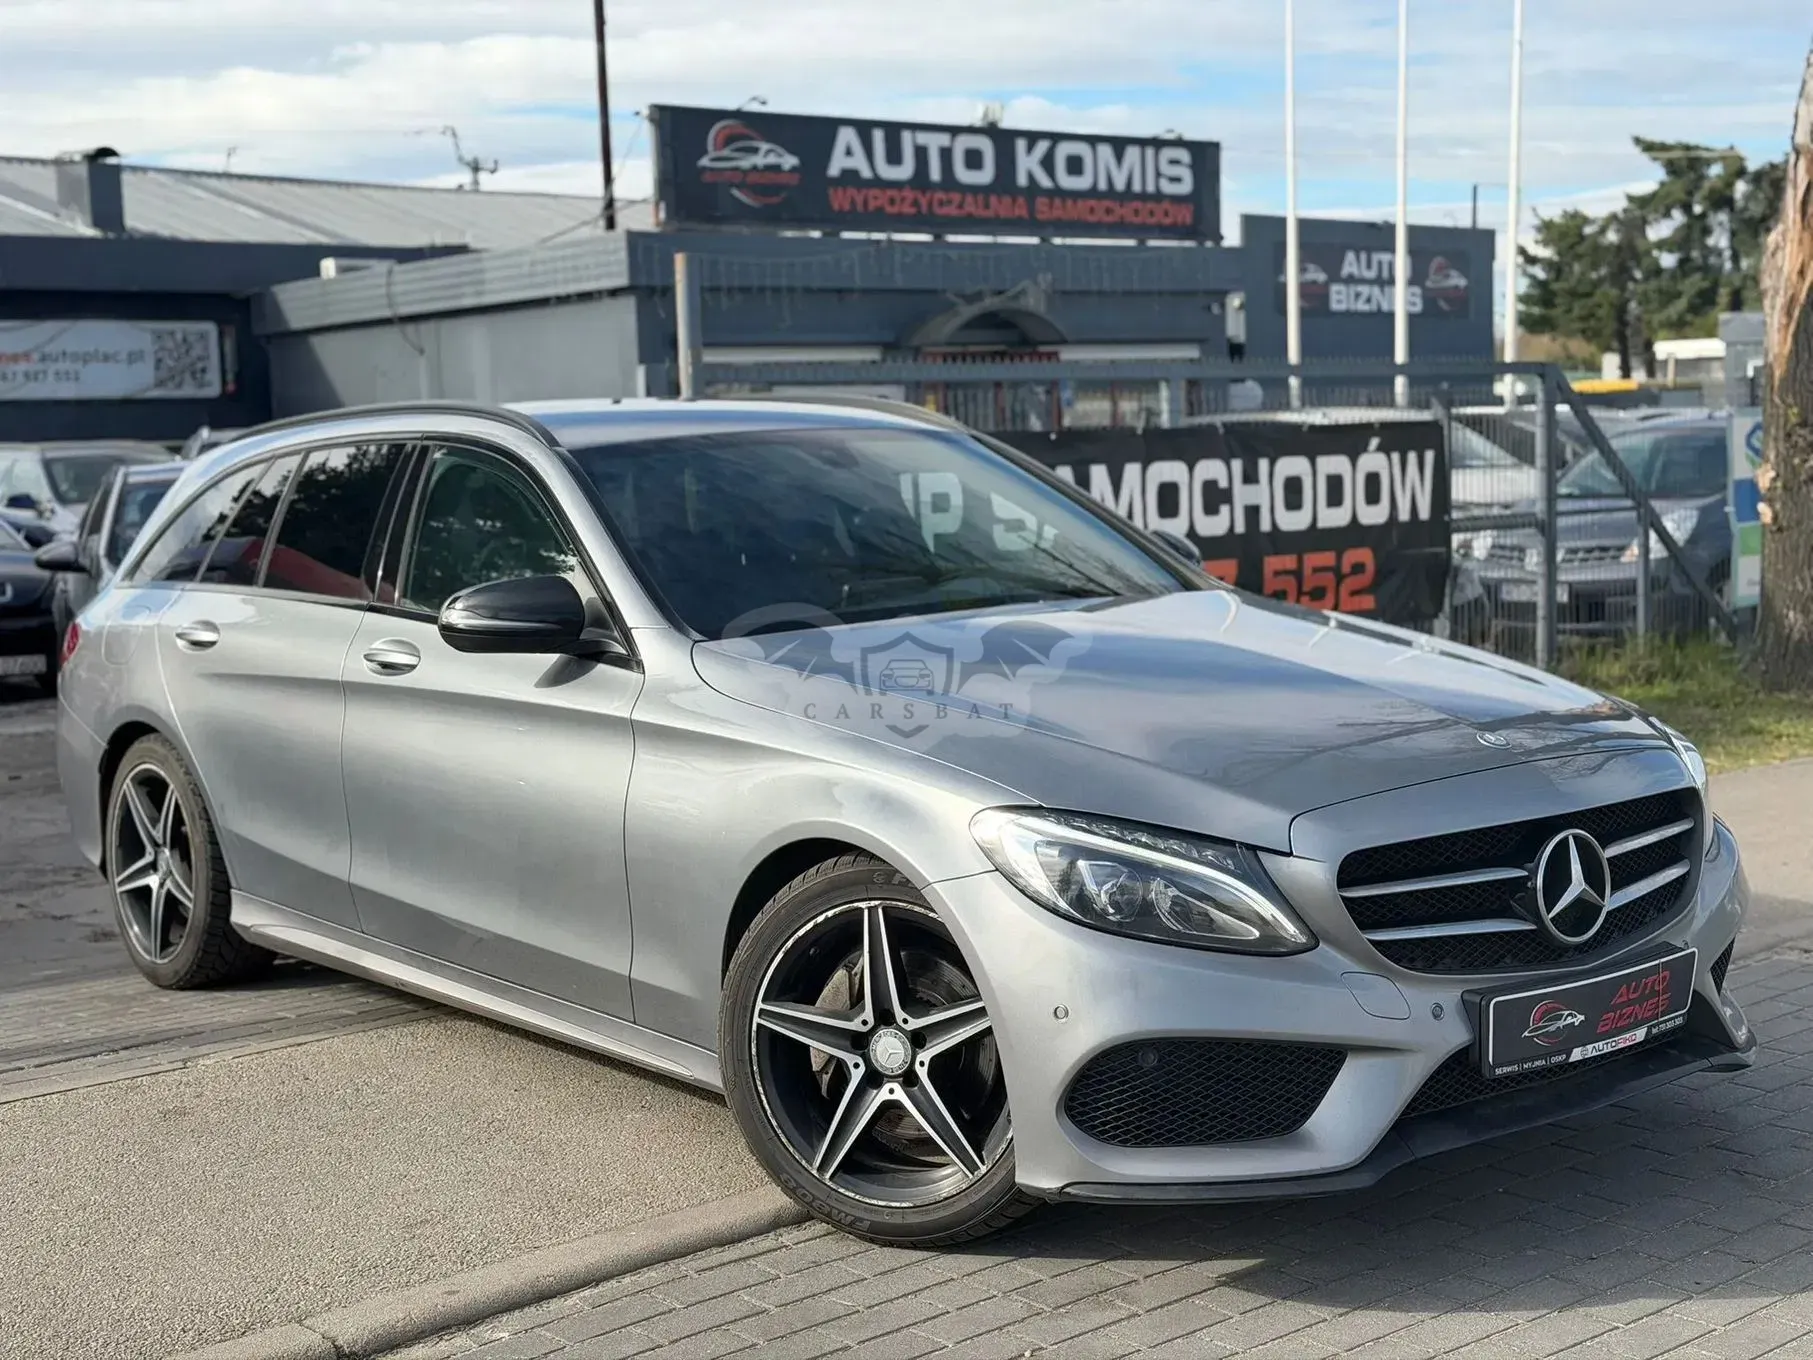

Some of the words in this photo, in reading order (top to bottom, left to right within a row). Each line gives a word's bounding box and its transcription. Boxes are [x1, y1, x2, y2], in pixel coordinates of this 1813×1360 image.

[826, 125, 995, 187] AUTO
[1014, 137, 1194, 196] KOMIS
[1035, 198, 1195, 227] SAMOCHODÓW
[1328, 283, 1423, 314] BIZNS
[1263, 547, 1376, 612] 552
[1610, 970, 1670, 1005] AUTO
